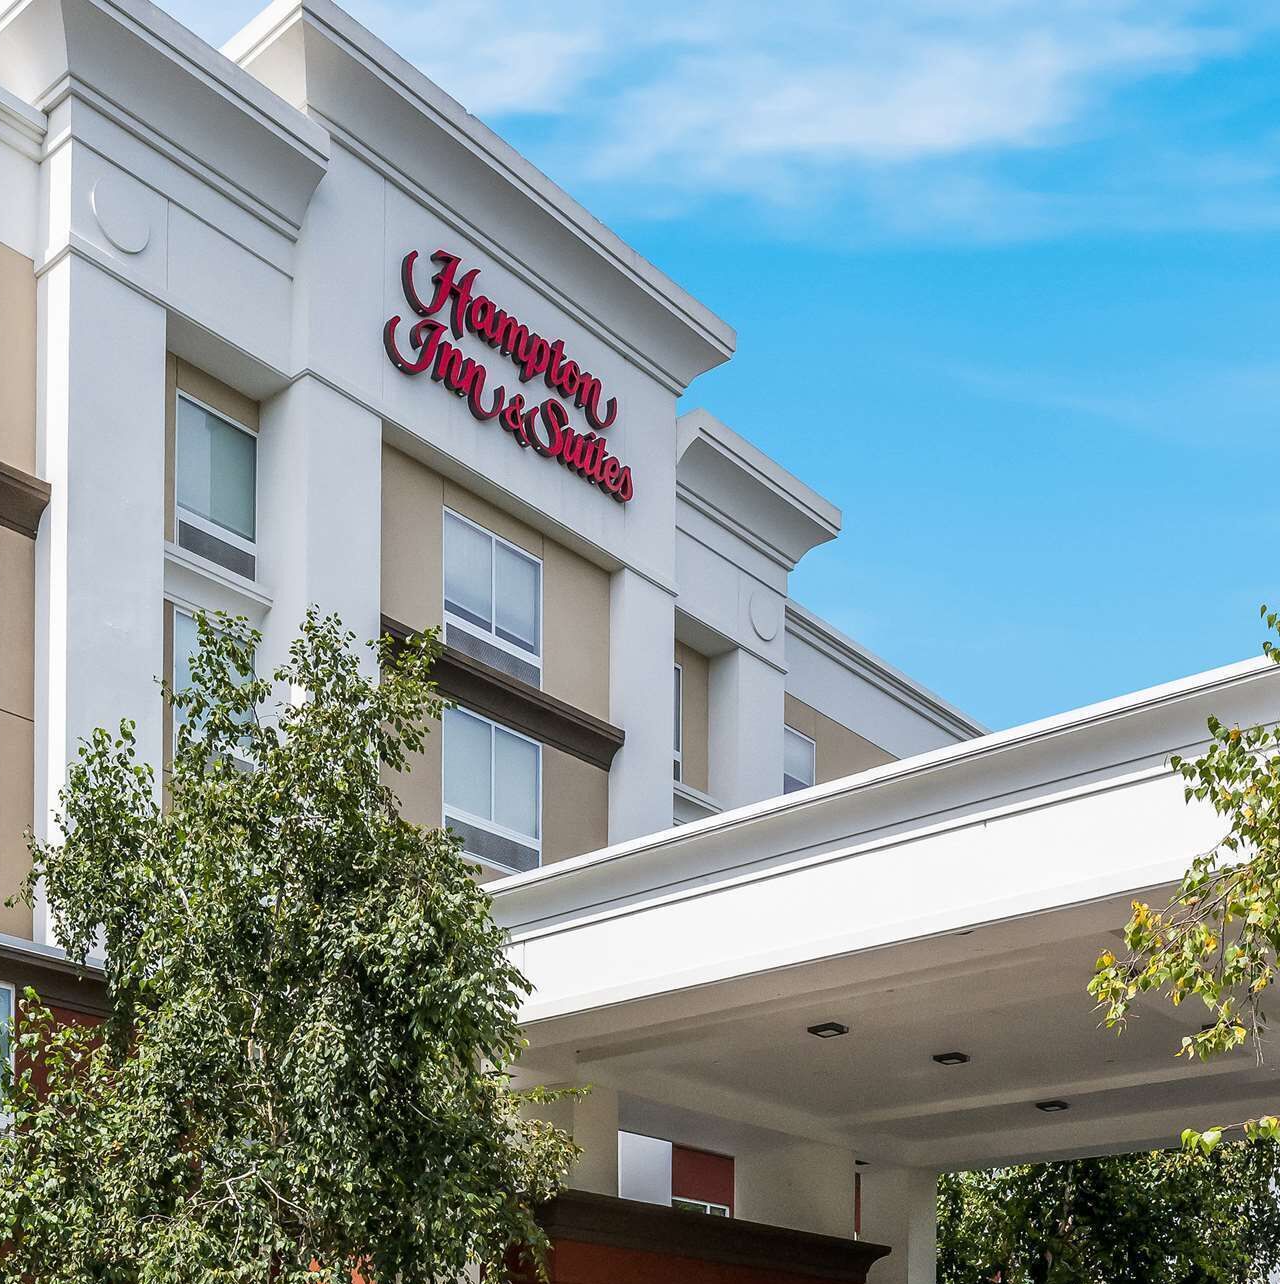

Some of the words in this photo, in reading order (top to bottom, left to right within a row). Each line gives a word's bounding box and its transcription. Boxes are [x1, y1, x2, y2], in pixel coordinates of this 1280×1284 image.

[382, 314, 505, 421] Inn
[498, 393, 531, 447] &
[523, 397, 634, 503] Suites
[400, 249, 618, 430] Hampton
